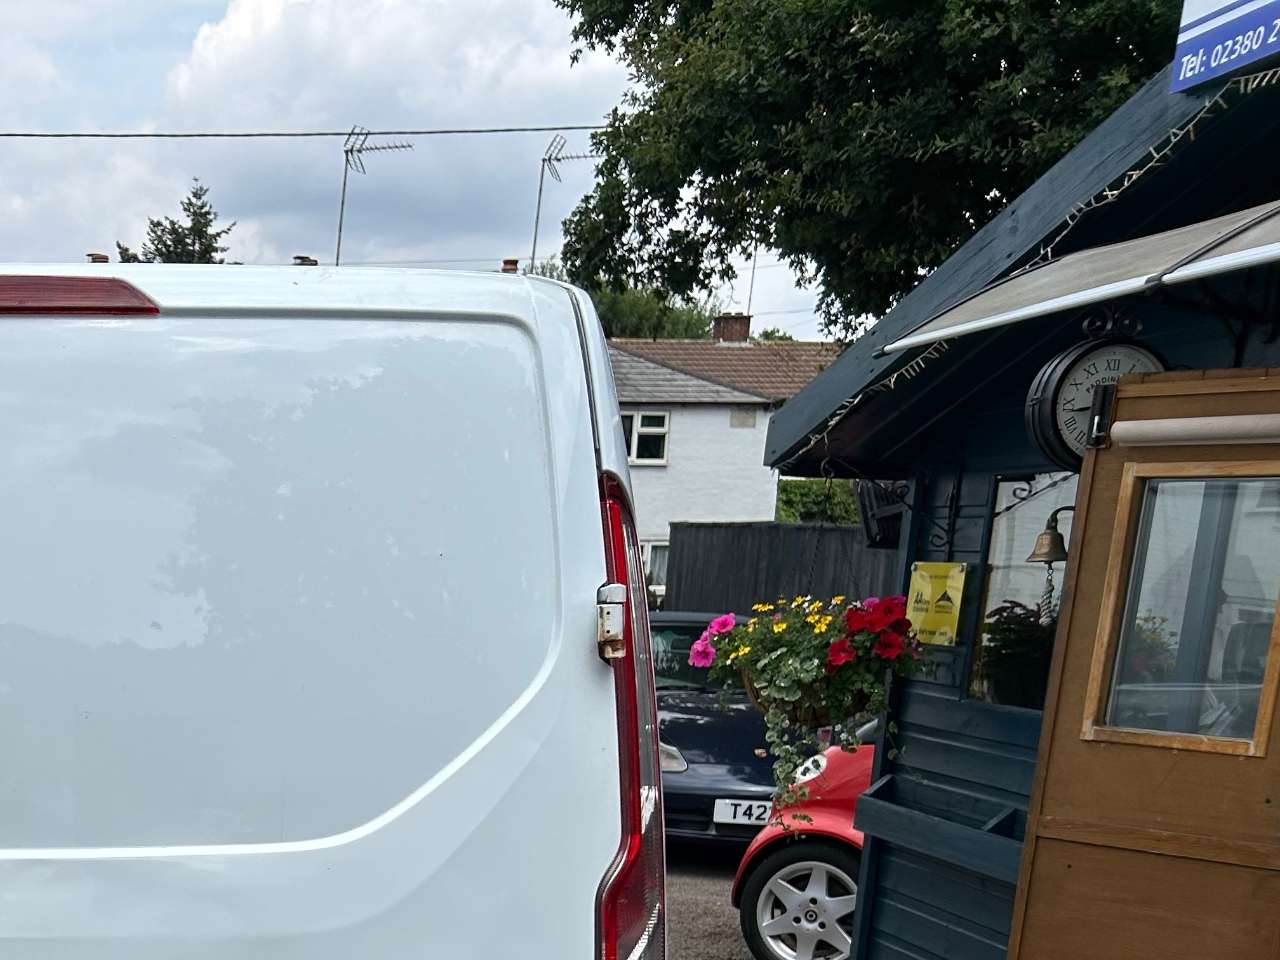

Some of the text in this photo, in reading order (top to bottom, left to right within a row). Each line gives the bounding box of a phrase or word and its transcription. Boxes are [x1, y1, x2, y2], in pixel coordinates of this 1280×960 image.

[1179, 47, 1207, 81] Tel:
[1210, 25, 1265, 68] 02380
[1104, 359, 1121, 371] XII
[730, 802, 771, 821] T42
